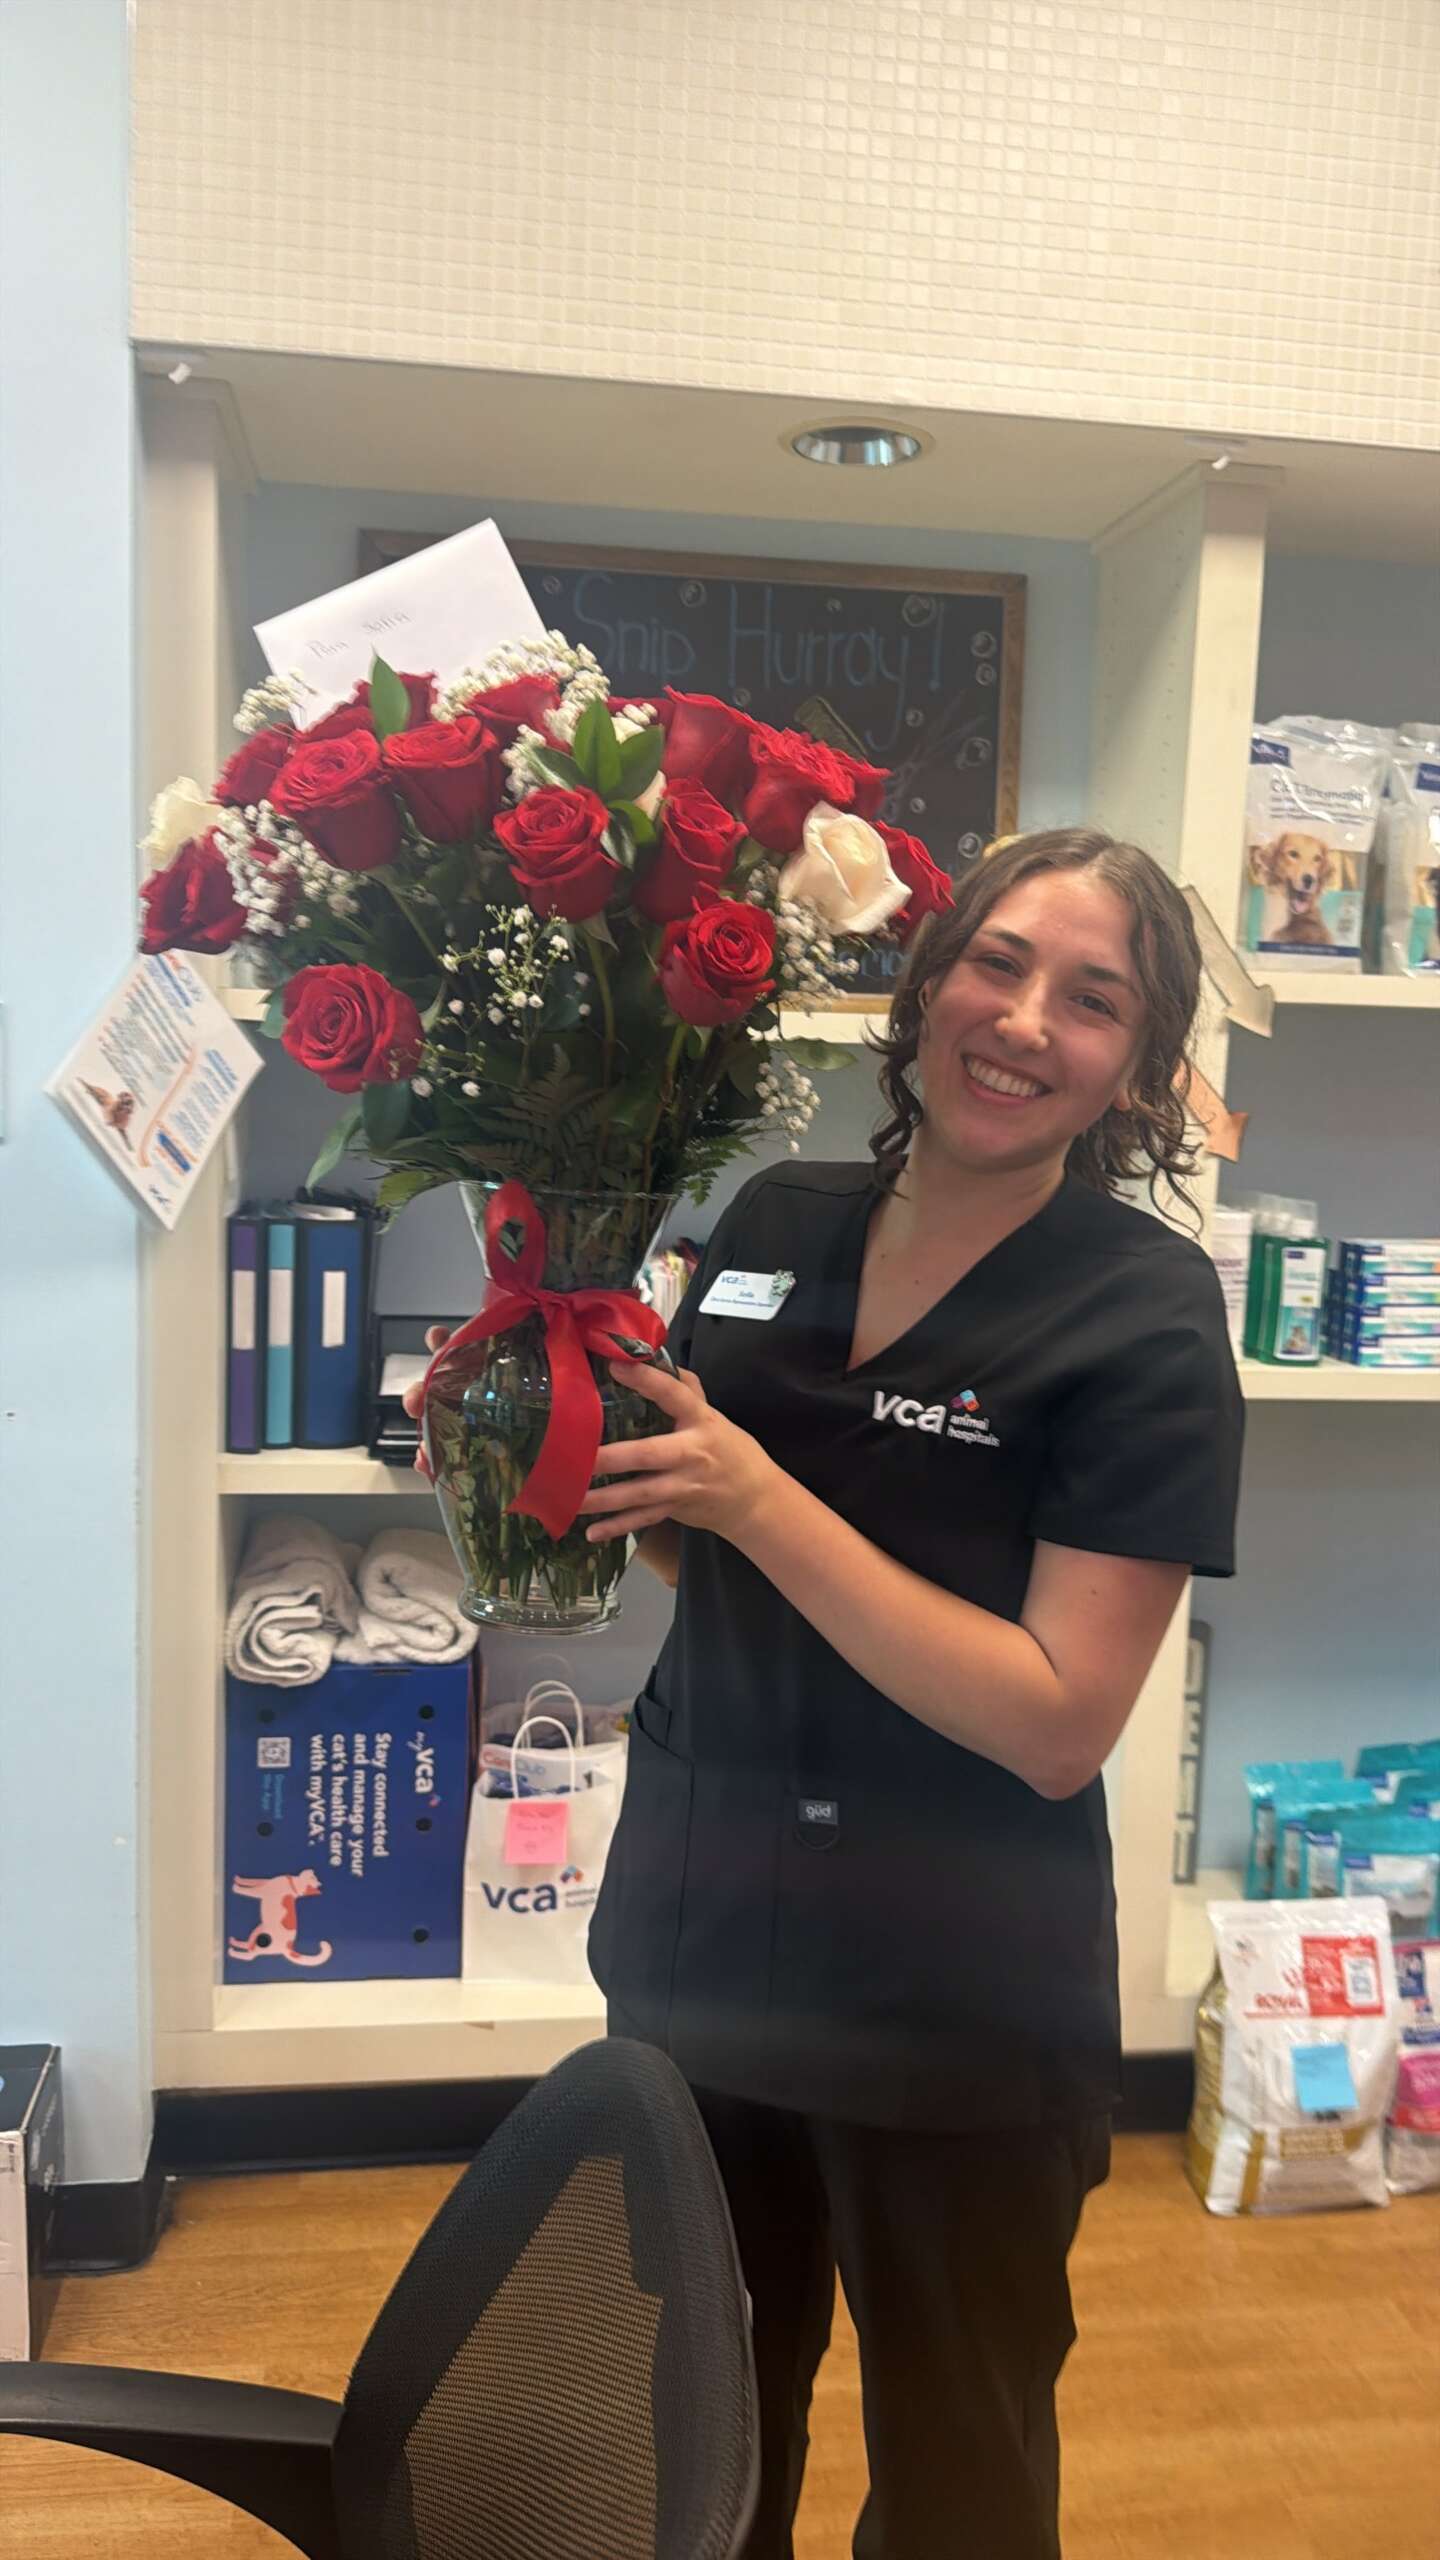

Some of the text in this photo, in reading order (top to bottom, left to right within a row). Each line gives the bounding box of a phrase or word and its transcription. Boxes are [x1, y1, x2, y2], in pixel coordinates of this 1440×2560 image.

[573, 572, 697, 680] Snip
[872, 1390, 947, 1434] vca
[950, 1413, 990, 1431] animal
[947, 1425, 1000, 1448] hospitals
[310, 1733, 328, 1772] with
[330, 1776, 350, 1828] health
[348, 1733, 370, 1877] and manage your
[372, 1732, 392, 1857] Stay connected
[329, 1831, 343, 1866] care
[481, 1882, 558, 1913] vca
